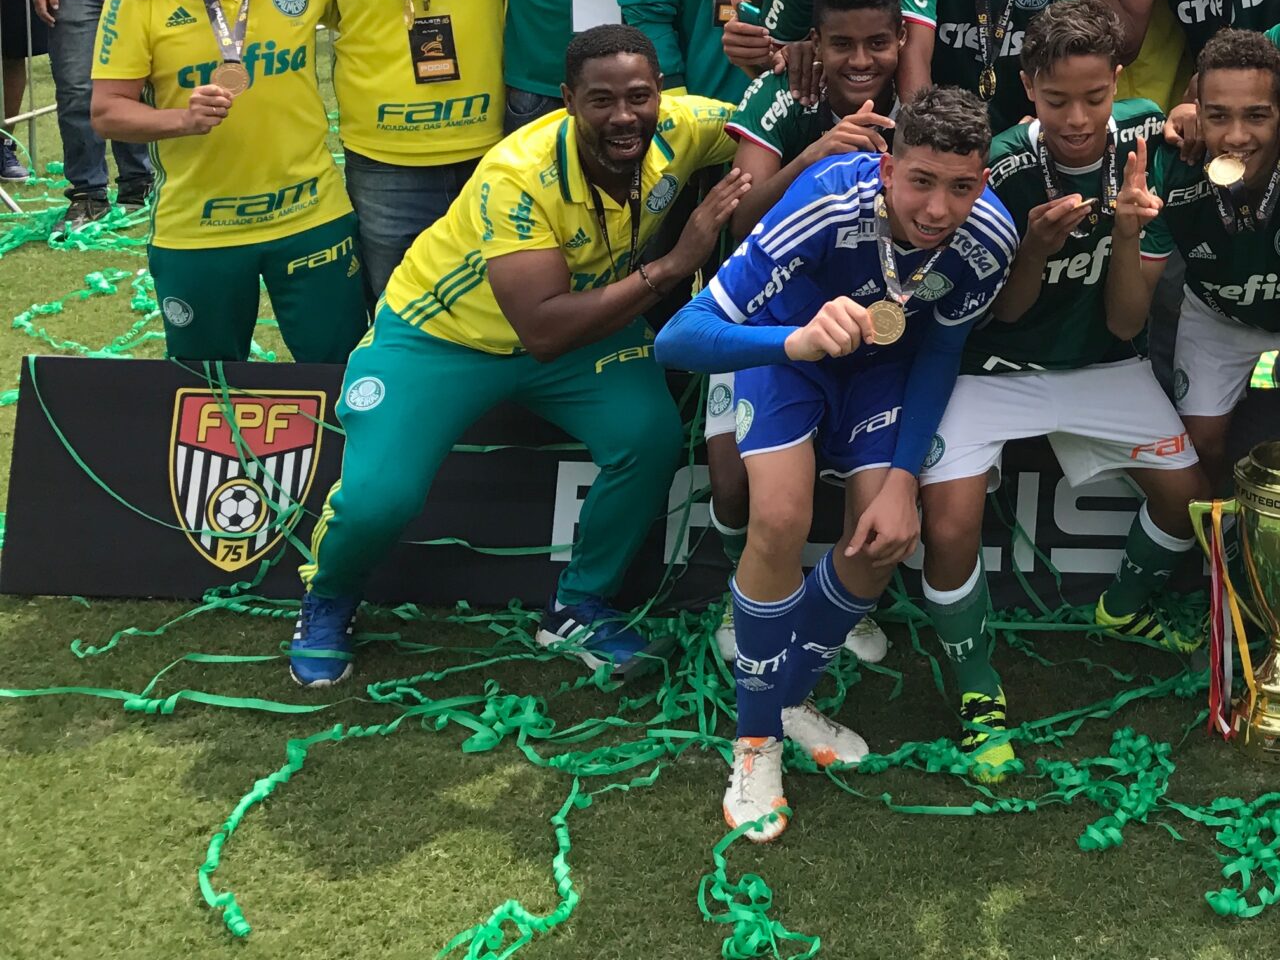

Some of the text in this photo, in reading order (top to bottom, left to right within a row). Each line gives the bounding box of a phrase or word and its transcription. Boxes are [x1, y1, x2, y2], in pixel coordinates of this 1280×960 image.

[165, 16, 197, 28] adidas
[939, 22, 1026, 60] creis
[177, 40, 307, 89] crfisa
[376, 123, 420, 131] FACULDADE
[423, 122, 442, 130] DAS
[1260, 171, 1278, 212] PAULISTA
[200, 197, 320, 227] FACULDADE DAS AMÉRICAS
[1188, 251, 1217, 260] adidas
[746, 256, 804, 315] crefia
[197, 402, 300, 443] FPF
[220, 544, 244, 562] 75
